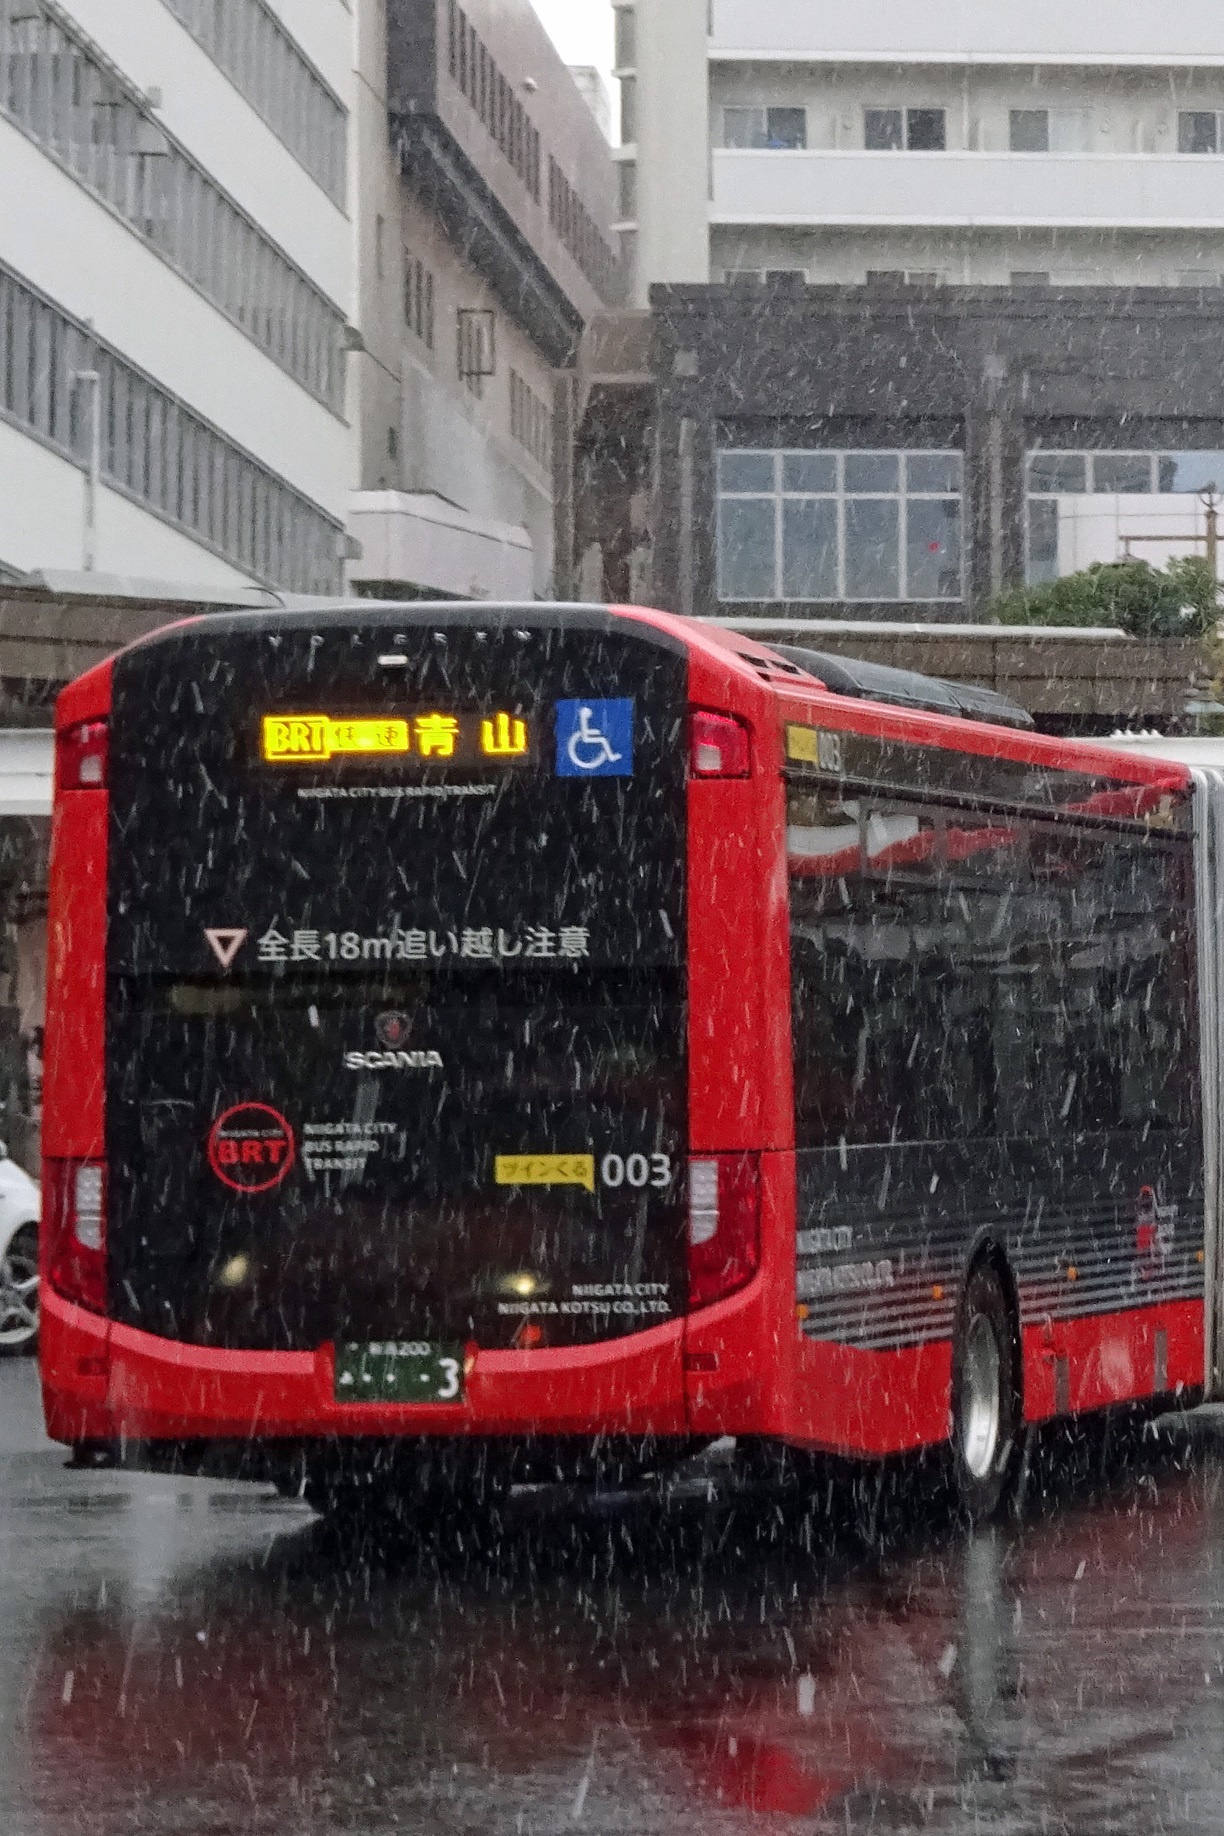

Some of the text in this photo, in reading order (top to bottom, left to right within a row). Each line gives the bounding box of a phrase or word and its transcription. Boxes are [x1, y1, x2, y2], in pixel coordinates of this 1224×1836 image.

[257, 928, 591, 961] 全長18m追い越し注意
[345, 1050, 444, 1069] SCANIA
[218, 1140, 287, 1164] BRT
[602, 1153, 672, 1187] 003
[635, 1283, 670, 1295] CITY
[561, 1301, 610, 1314] KOTSU
